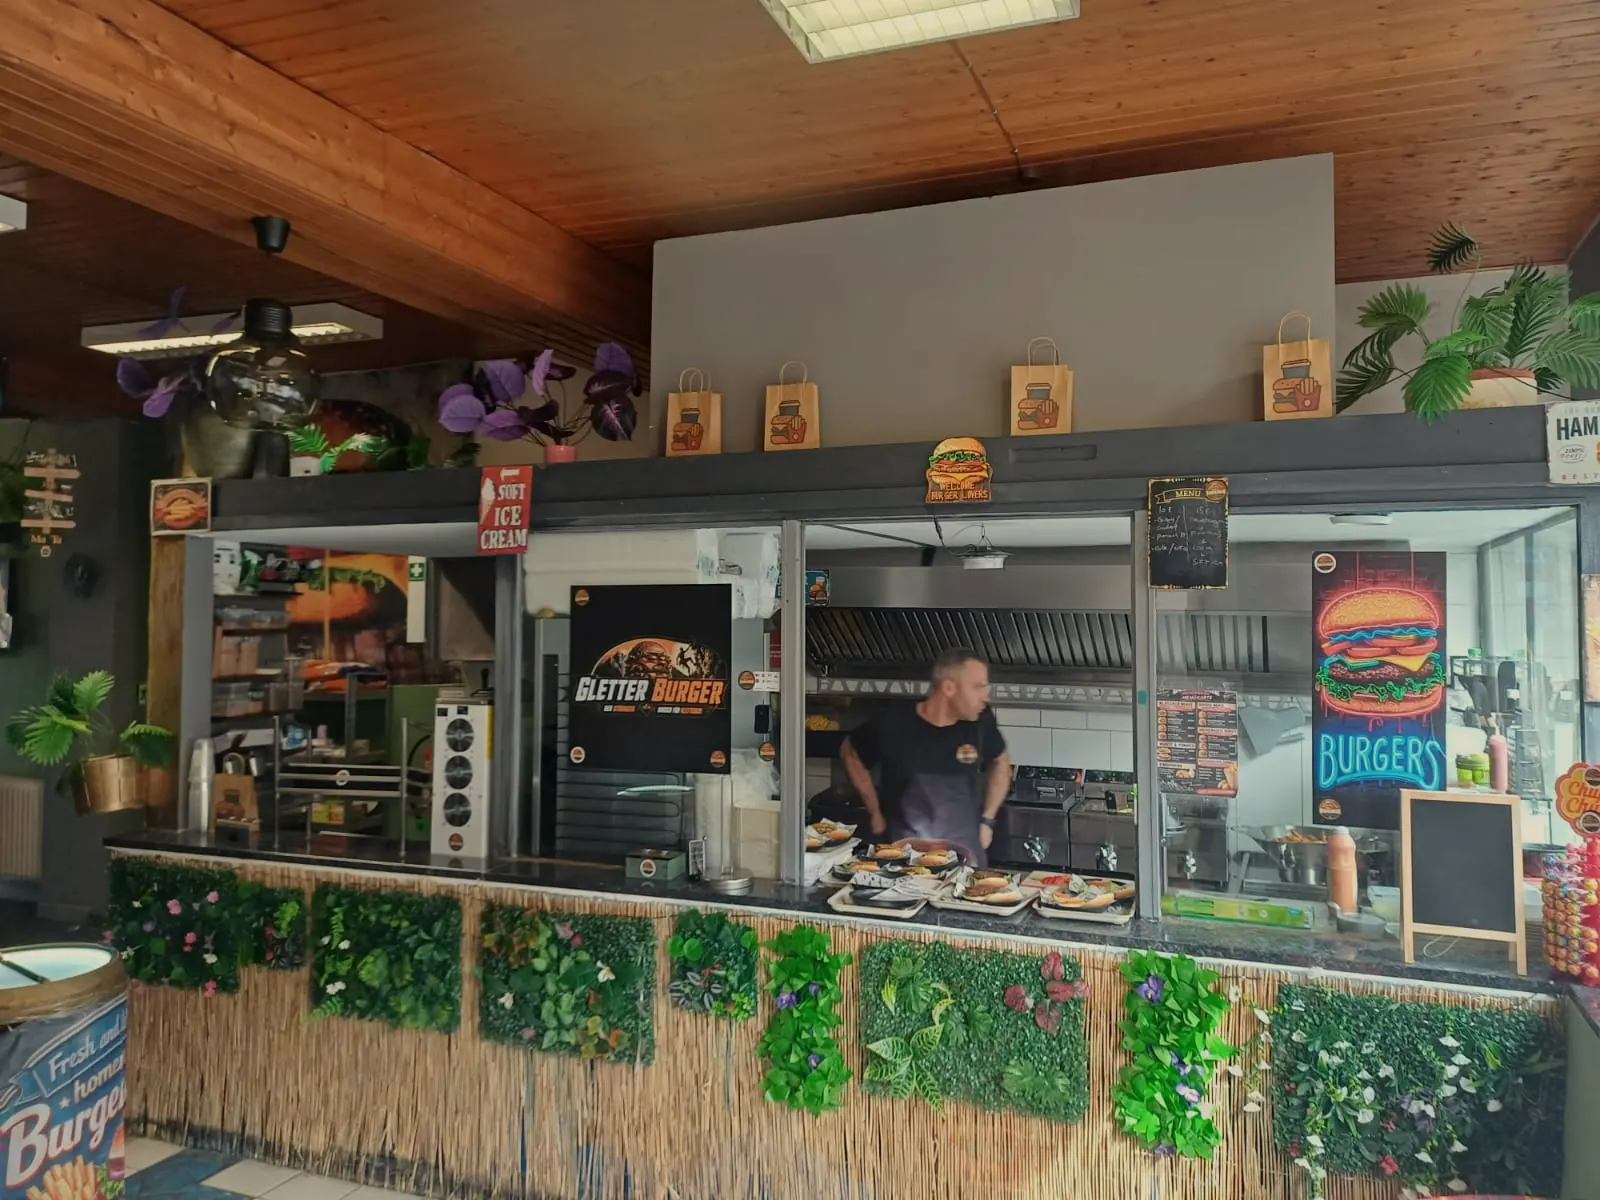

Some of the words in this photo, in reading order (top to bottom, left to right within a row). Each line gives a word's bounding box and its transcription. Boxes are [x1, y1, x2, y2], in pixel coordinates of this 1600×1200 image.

[497, 483, 526, 500] SOFT
[939, 481, 976, 491] WELCOME
[1175, 490, 1202, 498] MENU
[494, 505, 522, 527] ICE
[481, 529, 528, 549] CREAM
[575, 677, 650, 702] GLETTER
[651, 677, 725, 705] BURGER
[1320, 734, 1440, 791] BURGERS
[48, 1038, 96, 1082] Fresh
[99, 1013, 121, 1049] and
